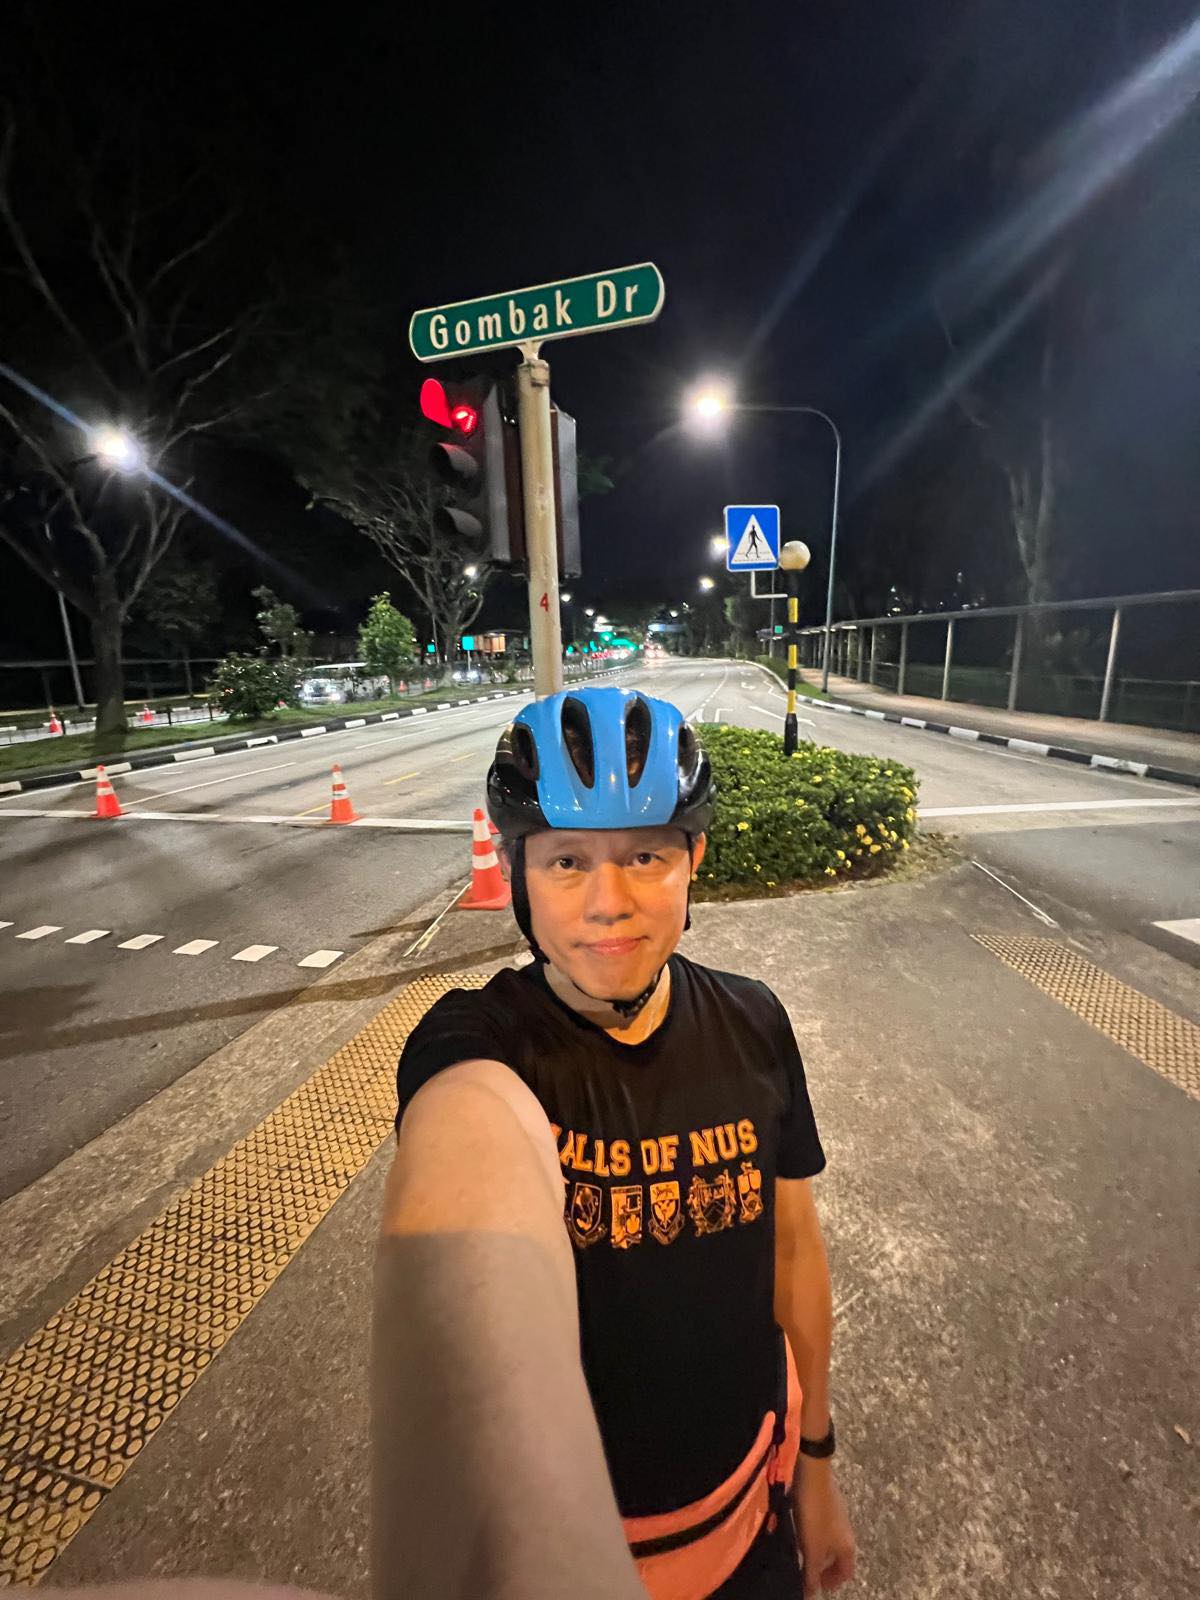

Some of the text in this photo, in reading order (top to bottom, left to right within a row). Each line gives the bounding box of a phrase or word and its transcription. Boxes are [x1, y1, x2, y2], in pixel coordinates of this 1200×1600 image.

[429, 279, 638, 349] Gombak Dr
[540, 592, 549, 612] 4
[551, 1118, 758, 1177] ALLS OF NUS
